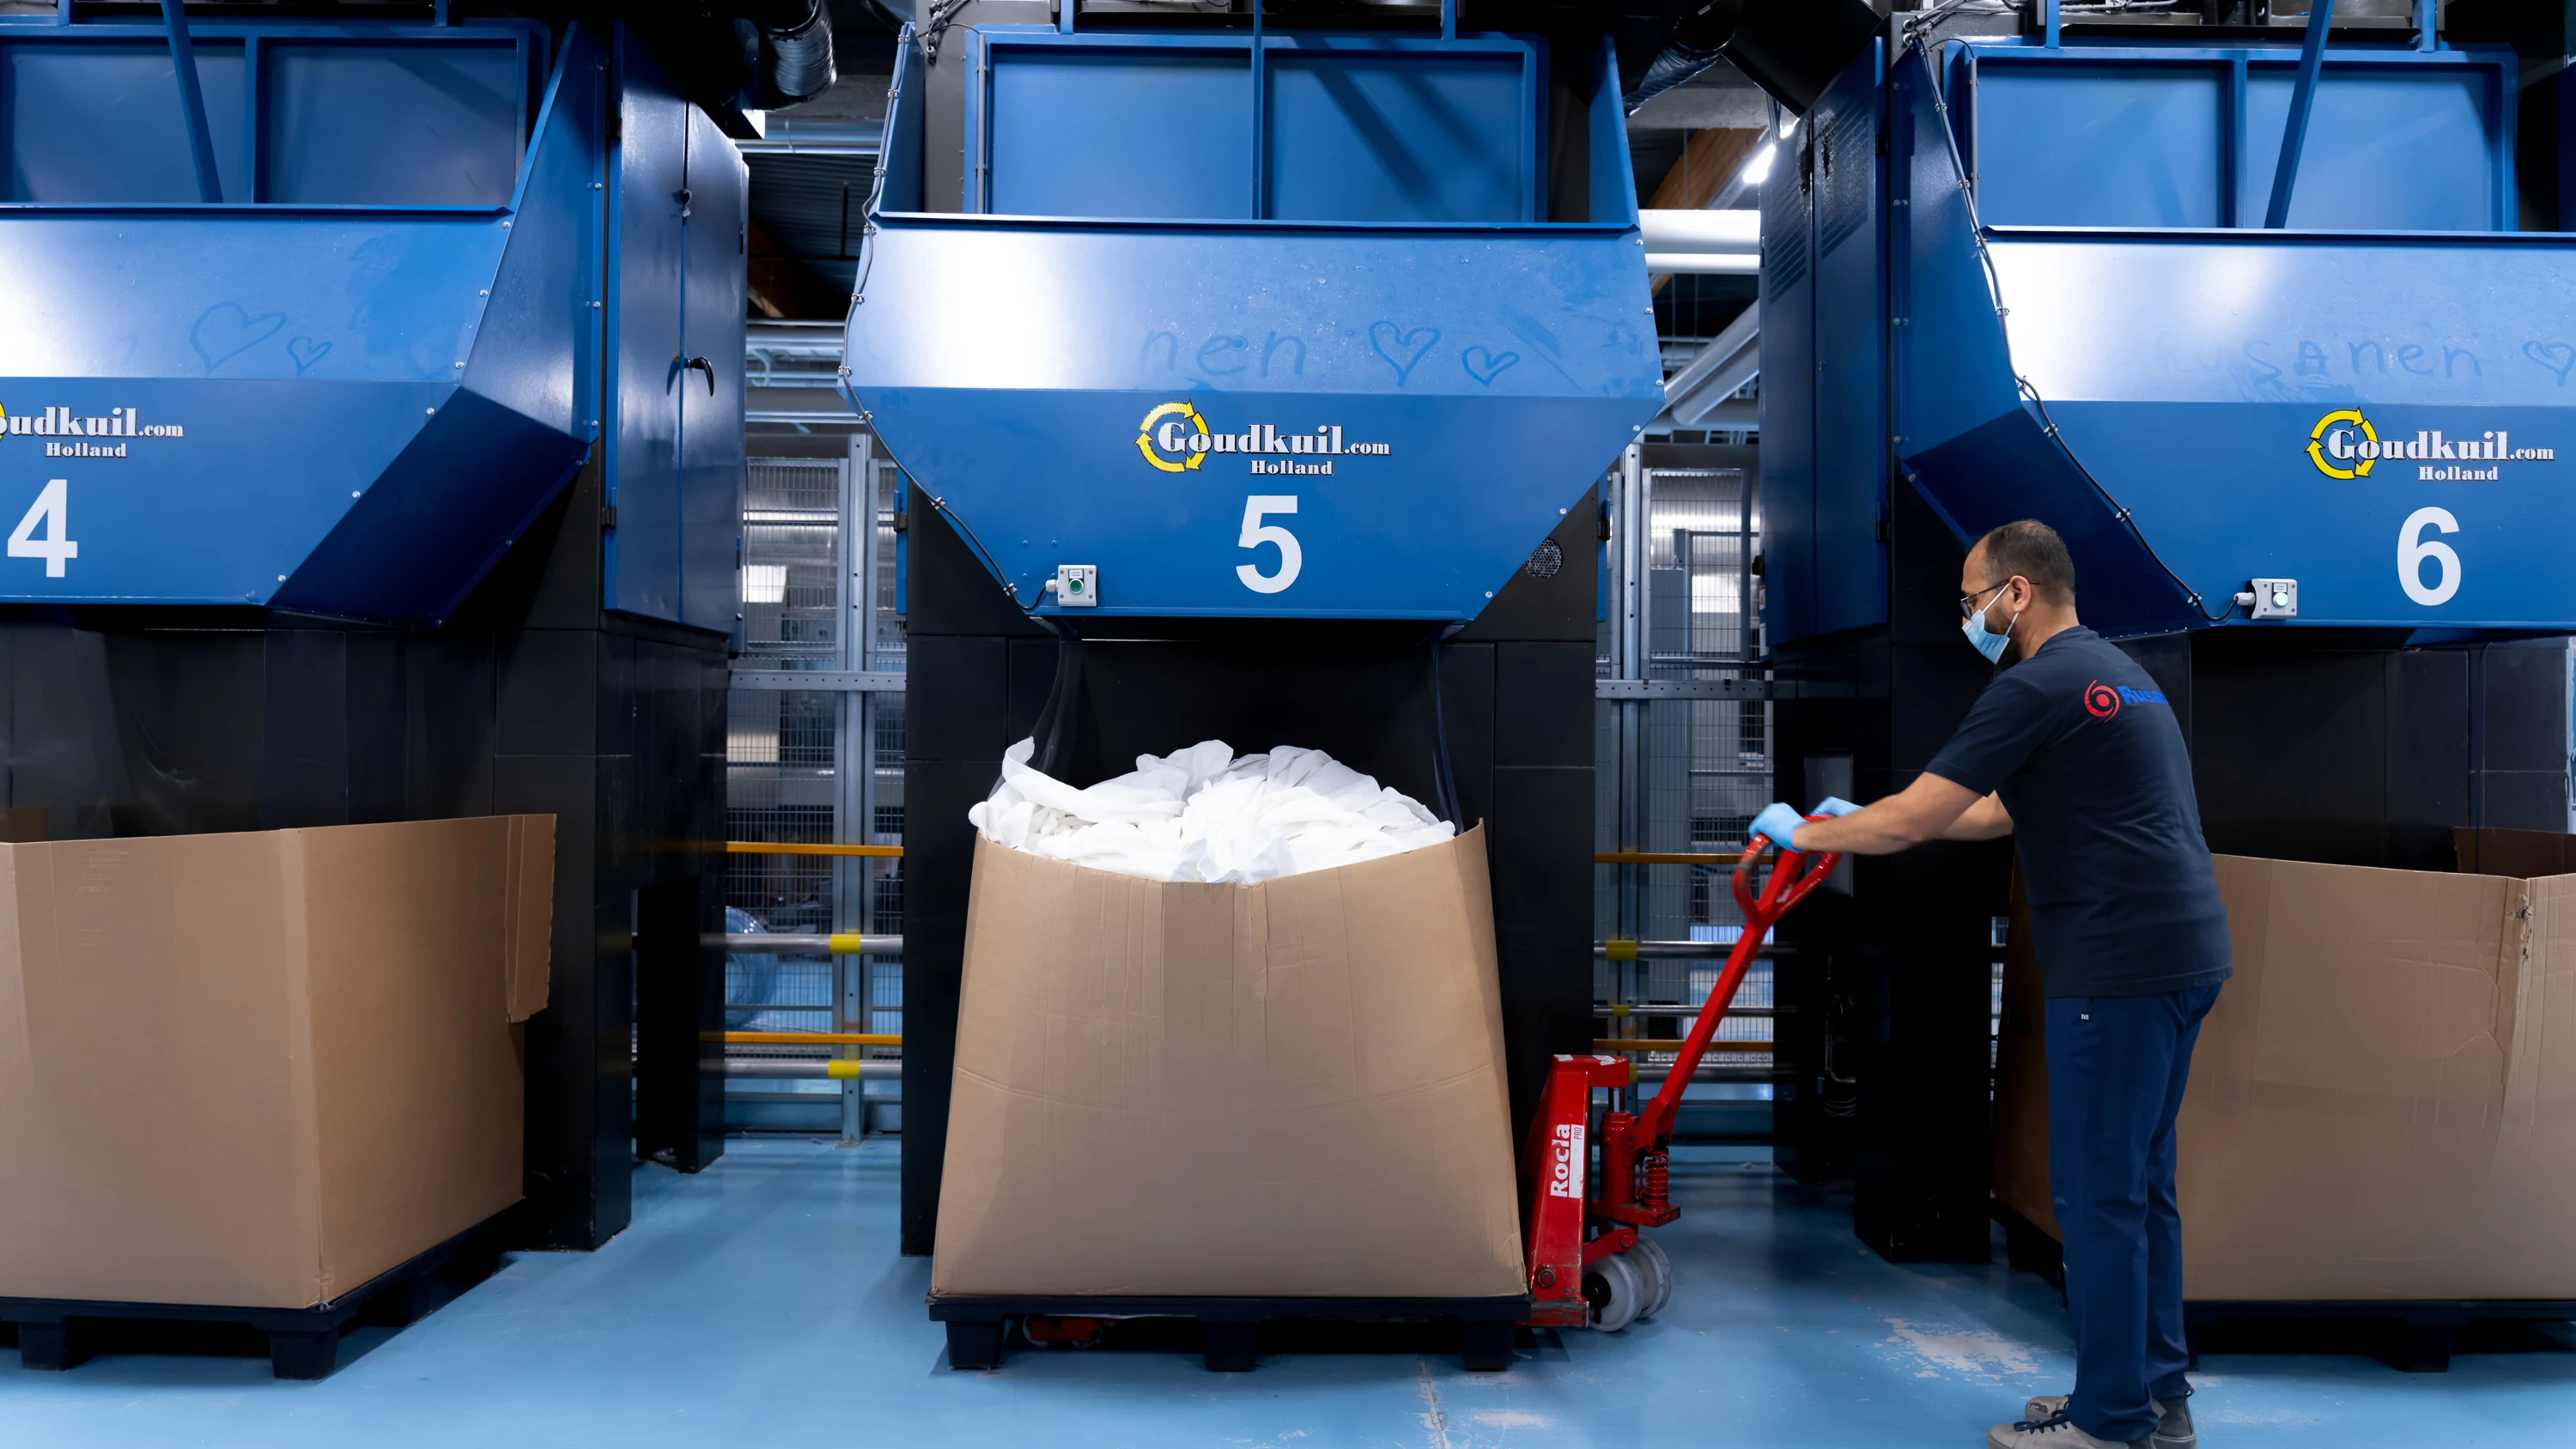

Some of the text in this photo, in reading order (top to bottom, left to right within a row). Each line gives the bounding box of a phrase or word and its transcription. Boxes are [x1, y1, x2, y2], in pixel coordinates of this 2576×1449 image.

[46, 442, 128, 458] Holland
[1157, 421, 1392, 457] Goudkuil.com
[2328, 429, 2556, 464] Goudkuil.com
[1249, 459, 1334, 476] Holland
[2418, 465, 2500, 482] Holland
[7, 479, 78, 578] 4
[1236, 495, 1303, 594] 5
[2397, 506, 2462, 606] 6
[1550, 1124, 1571, 1197] Rocla
